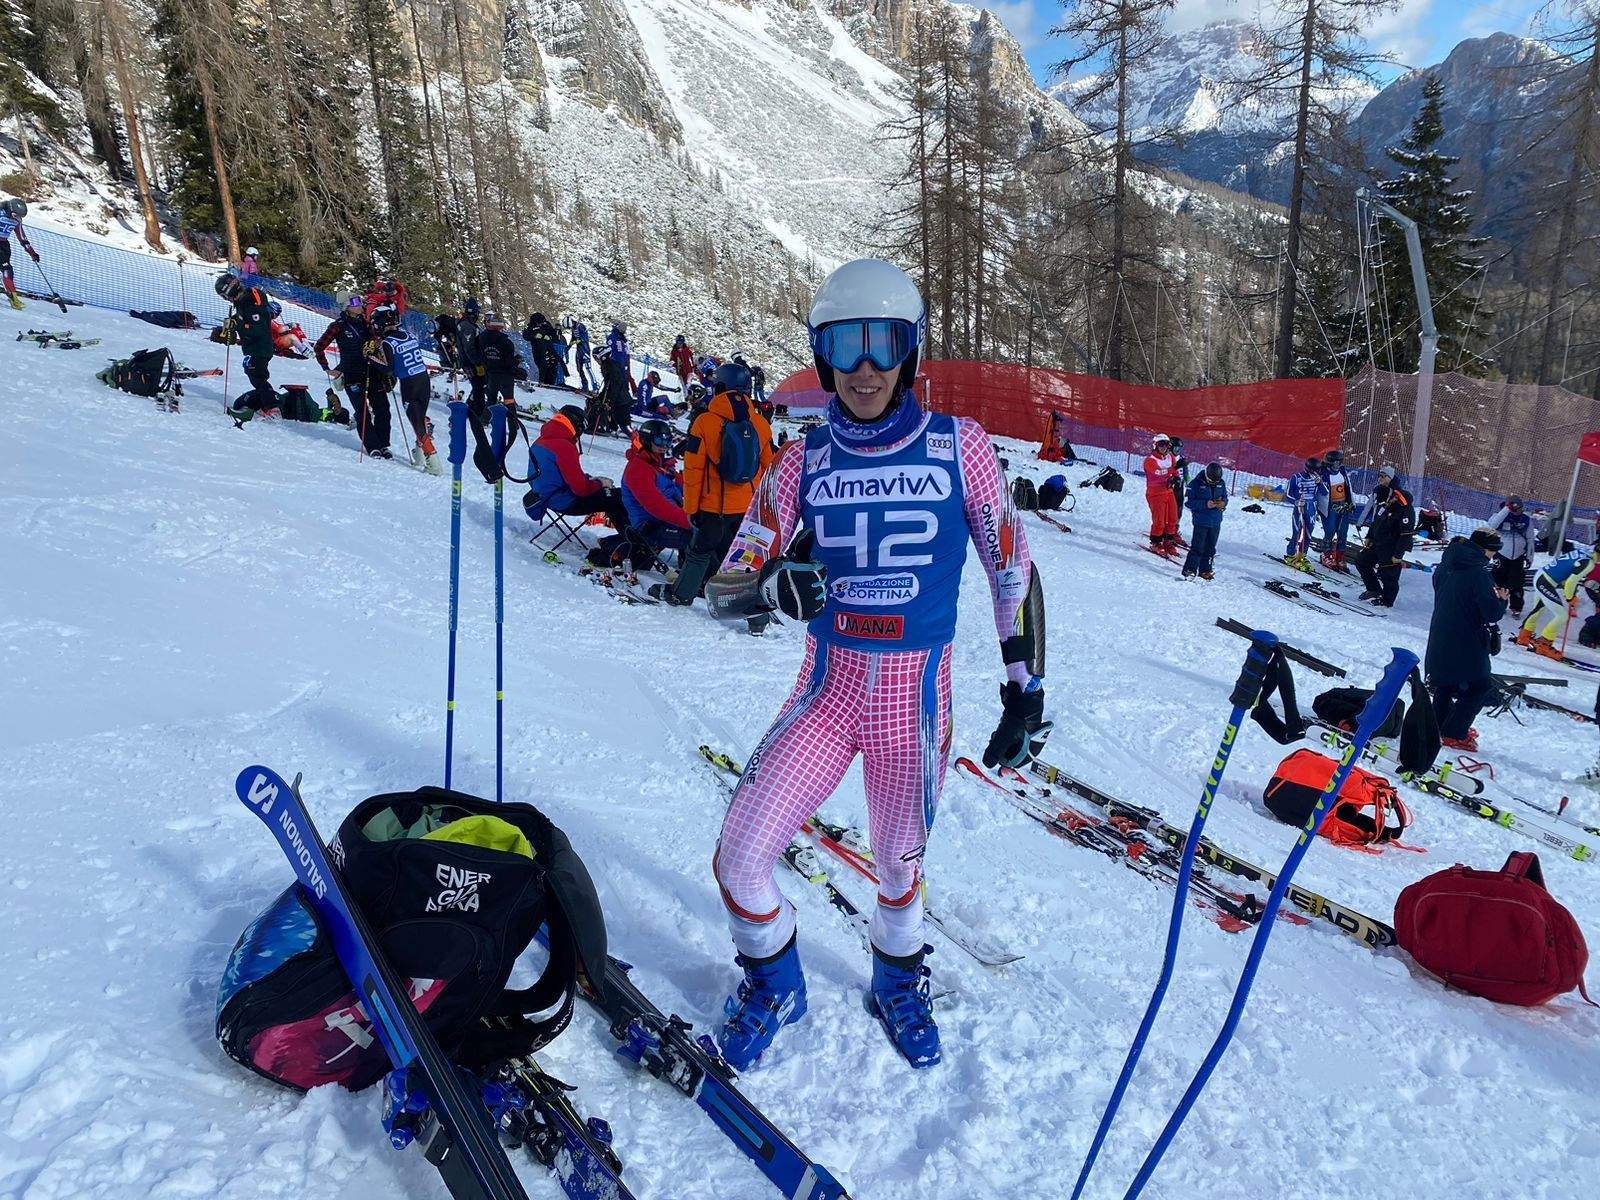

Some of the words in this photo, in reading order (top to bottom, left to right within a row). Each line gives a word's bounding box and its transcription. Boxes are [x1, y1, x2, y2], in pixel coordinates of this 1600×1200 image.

[815, 510, 938, 567] 42
[848, 589, 913, 600] CORTINA
[837, 614, 897, 635] UMANA
[279, 809, 328, 900] SALOMON
[436, 863, 491, 888] ENER
